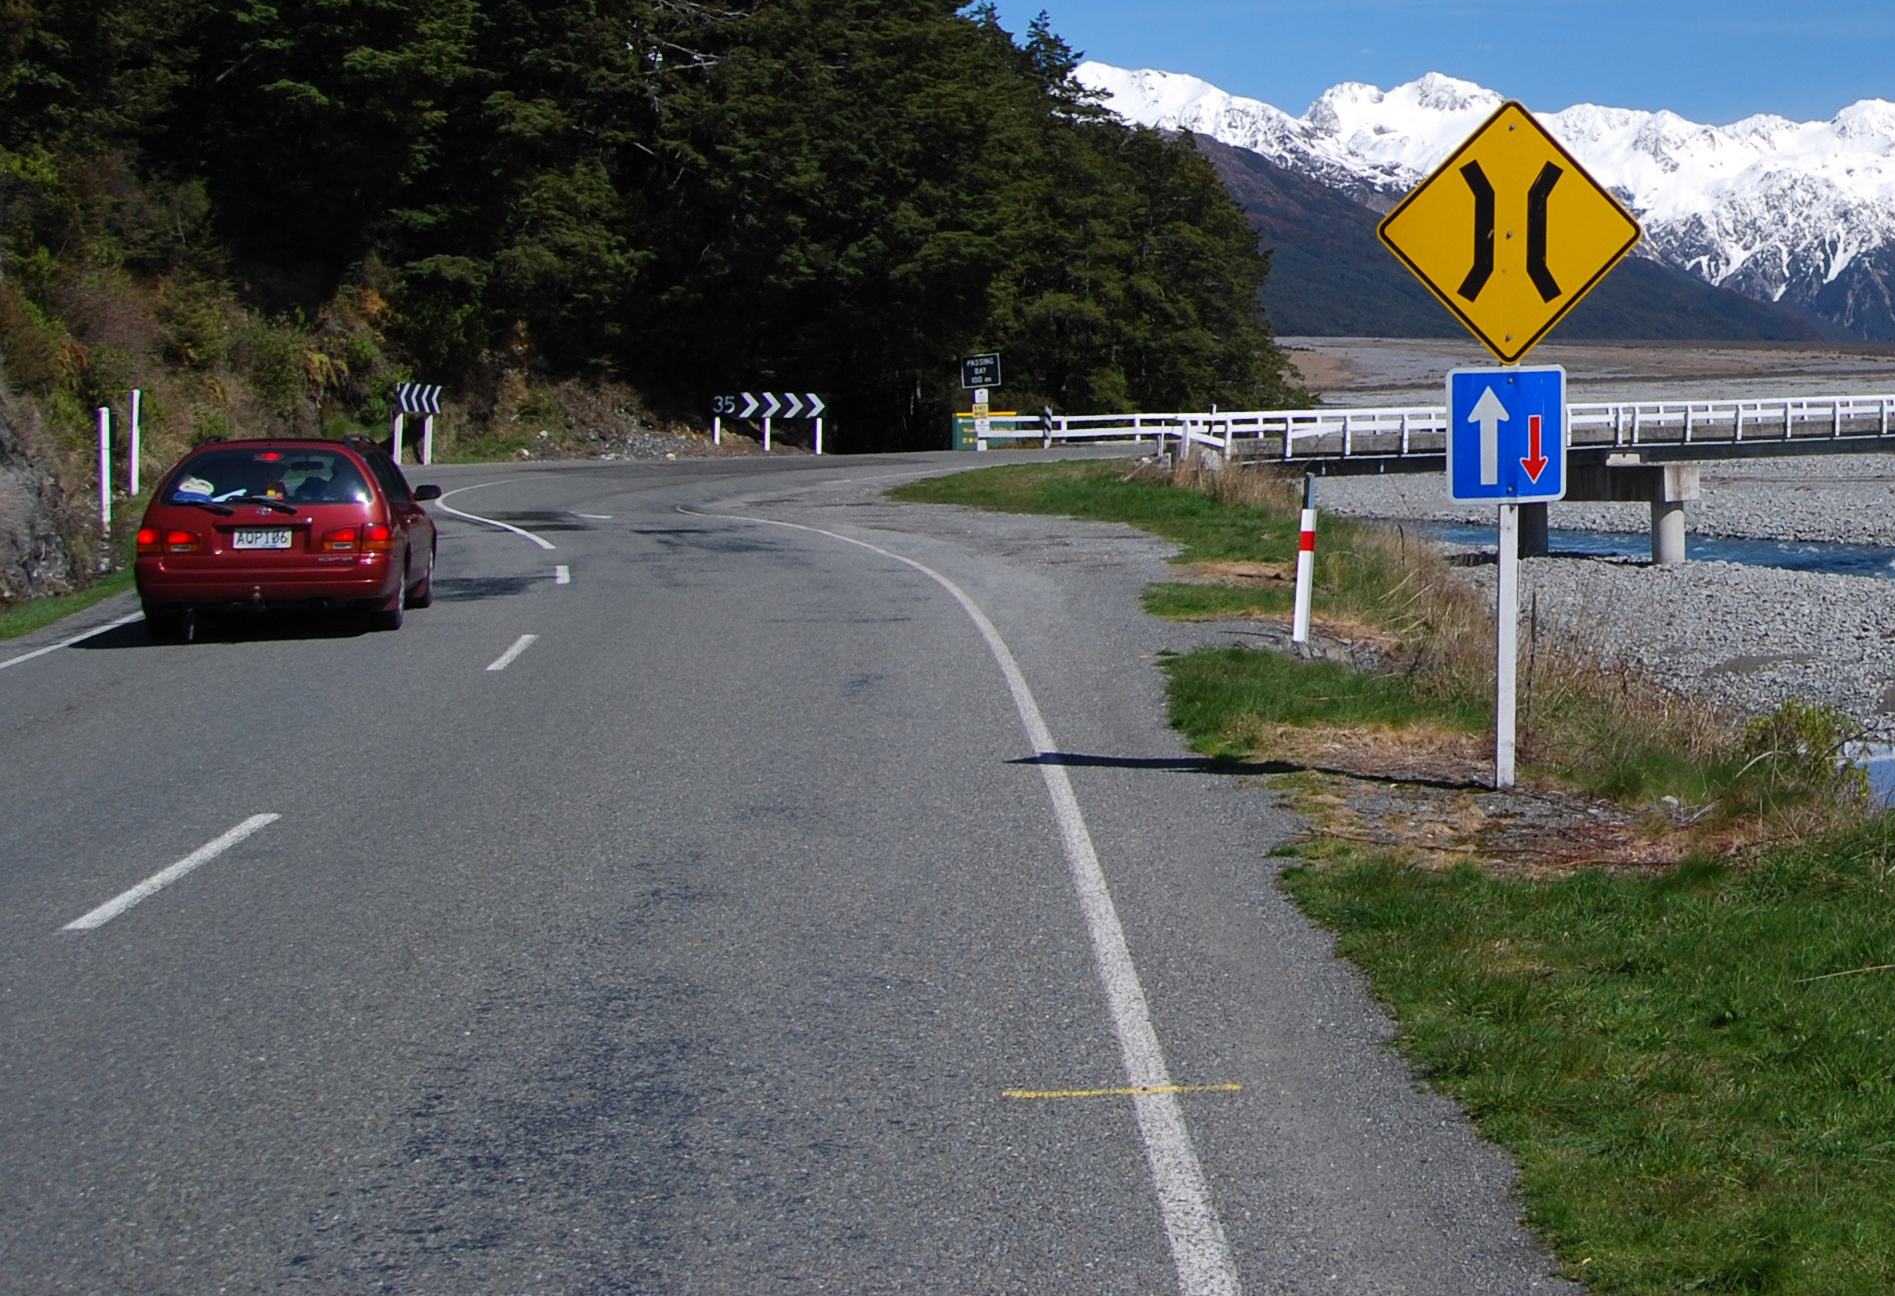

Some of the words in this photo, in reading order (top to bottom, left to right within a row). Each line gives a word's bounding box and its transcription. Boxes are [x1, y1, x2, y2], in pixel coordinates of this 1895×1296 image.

[966, 357, 995, 367] PASSING
[974, 366, 987, 375] BAY
[712, 395, 736, 414] 35
